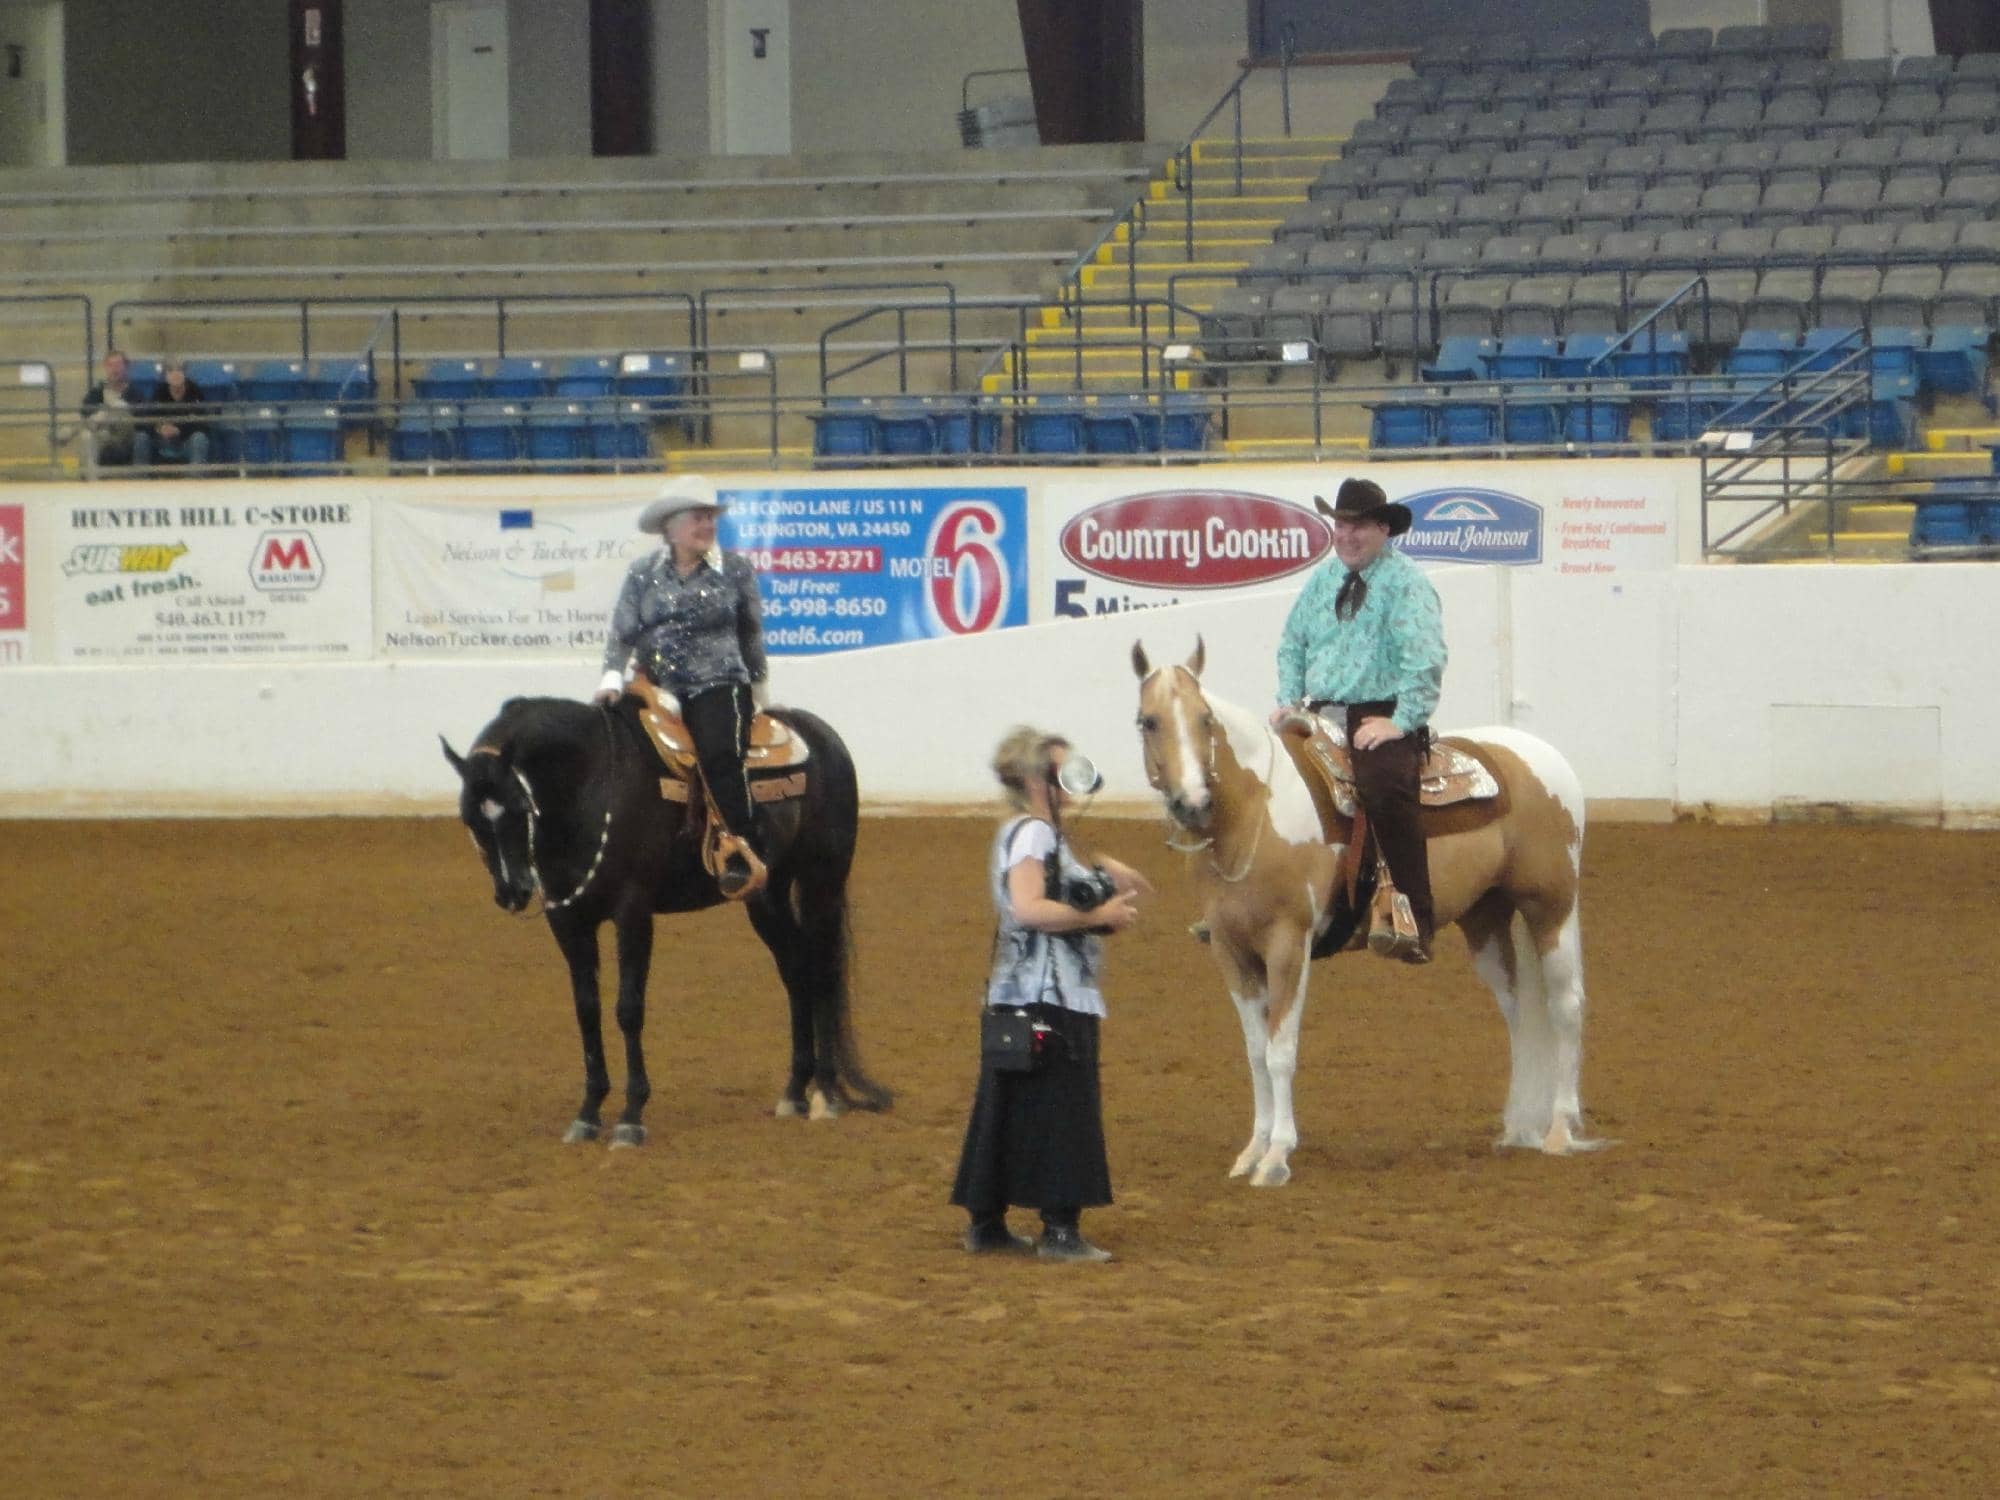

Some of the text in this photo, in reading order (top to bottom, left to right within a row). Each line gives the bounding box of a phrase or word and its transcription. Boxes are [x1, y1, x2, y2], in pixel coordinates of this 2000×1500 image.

[750, 501, 806, 515] ECONO
[809, 501, 850, 515] LANE
[863, 500, 884, 515] US
[889, 500, 906, 514] 11
[911, 500, 923, 514] N
[1594, 496, 1646, 510] Renovated
[72, 504, 351, 528] HUNTER HILL C-STORE
[740, 521, 910, 540] LEXINGTON, VA 24450
[1459, 525, 1532, 552] Johnson
[442, 541, 500, 562] Nelson
[1080, 516, 1311, 568] Country Cookin
[61, 540, 189, 577] SUBWAY
[262, 538, 311, 570] M
[737, 550, 875, 570] 40-463-7371
[890, 557, 955, 578] MOTEL
[930, 505, 1004, 635] 6
[85, 584, 124, 606] eat
[771, 578, 840, 595] Toll Free:
[406, 610, 445, 626] Legal
[448, 610, 503, 625] Services
[508, 609, 530, 624] For
[537, 609, 561, 624] The
[386, 631, 550, 647] NelsonTucker.com
